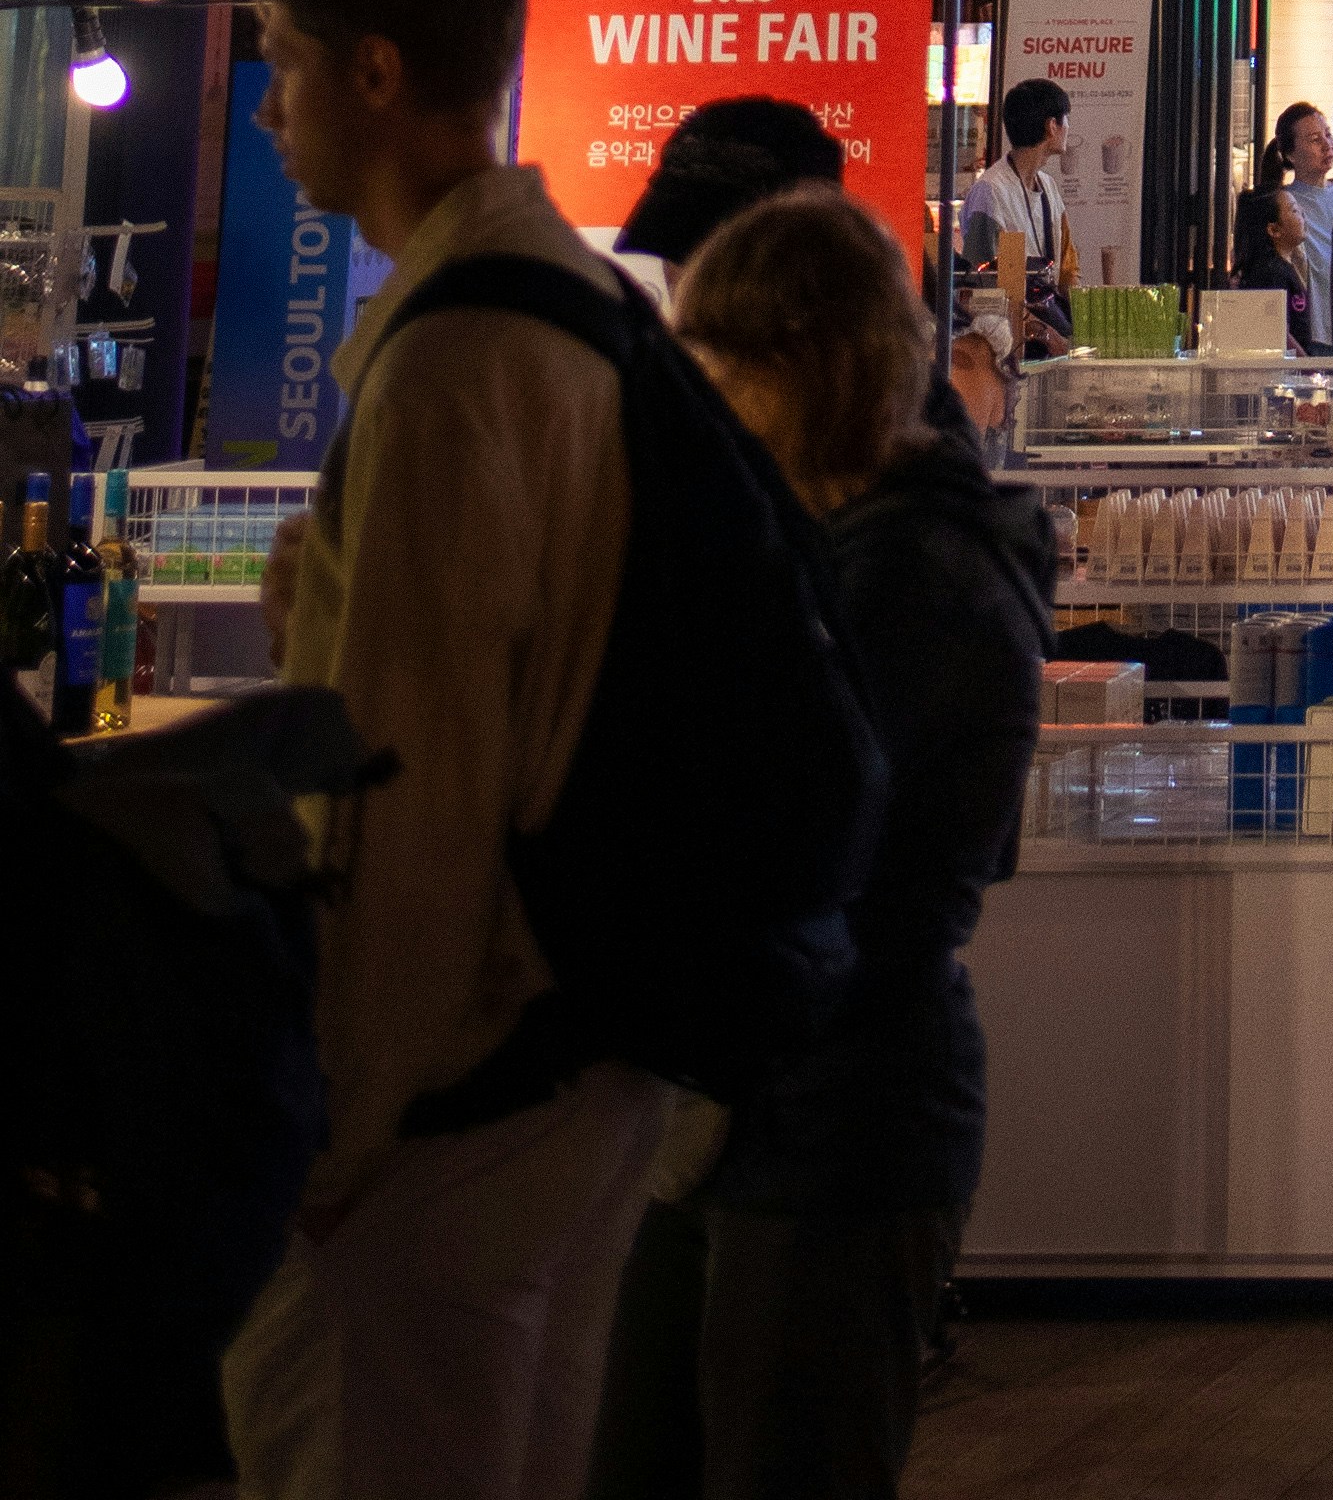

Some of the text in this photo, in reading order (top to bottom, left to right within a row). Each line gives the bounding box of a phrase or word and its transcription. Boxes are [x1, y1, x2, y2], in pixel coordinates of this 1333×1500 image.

[587, 11, 879, 64] WINE FAIR
[1023, 36, 1134, 54] SIGNATURE
[1047, 61, 1106, 79] MENU
[586, 139, 654, 167] 음악과
[279, 285, 326, 441] SEOUL
